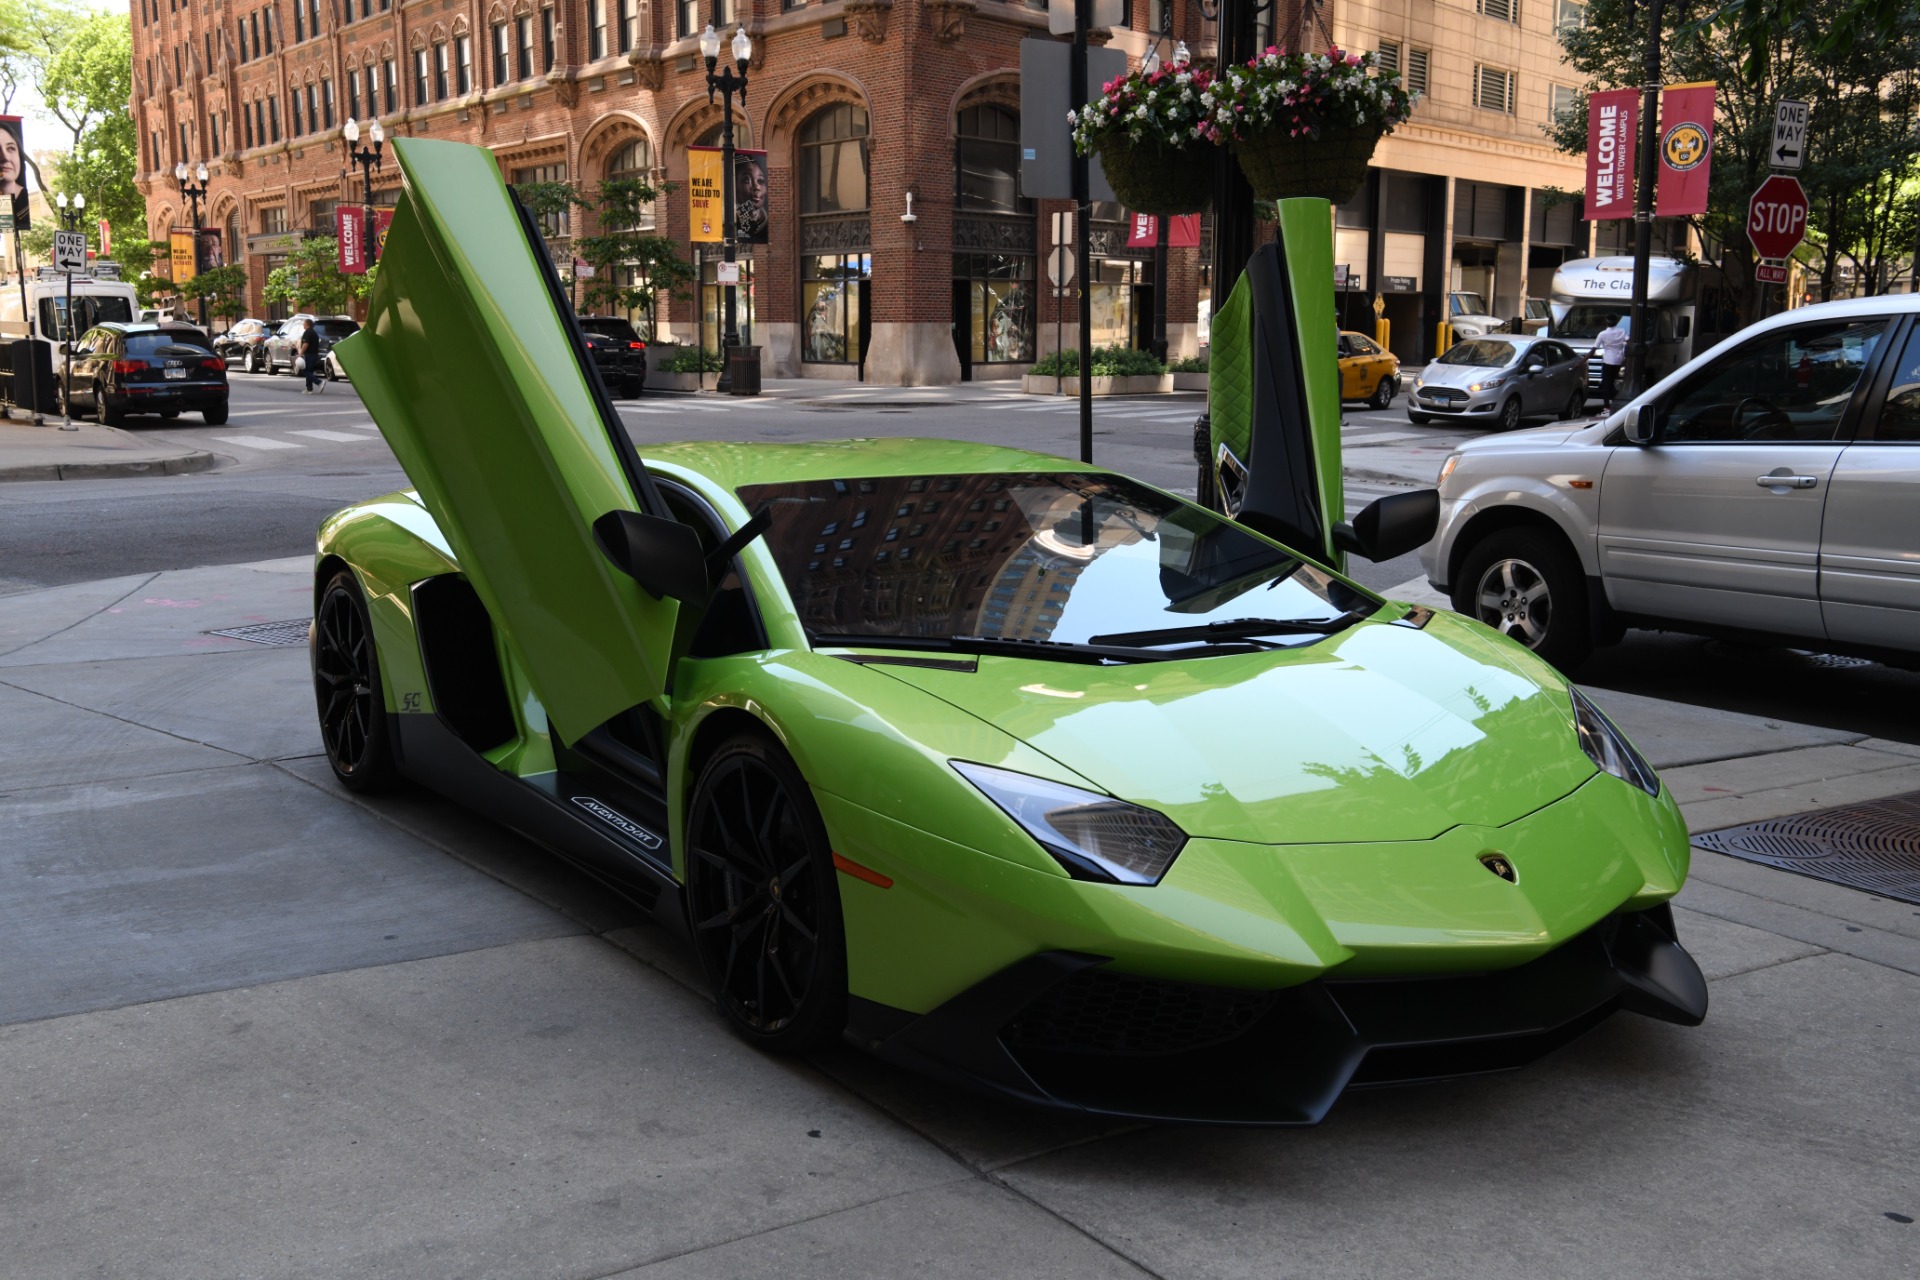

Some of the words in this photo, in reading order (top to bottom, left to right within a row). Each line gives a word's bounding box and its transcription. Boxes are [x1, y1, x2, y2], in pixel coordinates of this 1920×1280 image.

[1779, 106, 1804, 123] ONE
[1619, 110, 1628, 143] CAMPUS
[1777, 124, 1803, 142] WAY
[1595, 105, 1617, 207] WELCOME
[1617, 144, 1626, 172] TOWER
[691, 178, 700, 187] WE
[701, 178, 713, 187] ARE
[1616, 173, 1625, 200] WATER
[691, 188, 712, 198] CALLED
[712, 189, 720, 198] TO
[692, 199, 709, 209] SOLVE
[1751, 201, 1805, 234] STOP
[58, 234, 82, 246] ONE
[343, 213, 354, 266] WELCOME
[58, 246, 83, 257] WAY
[1759, 267, 1771, 278] ALL
[1772, 269, 1786, 280] WAY
[1583, 279, 1606, 290] The
[1610, 279, 1633, 290] Cla
